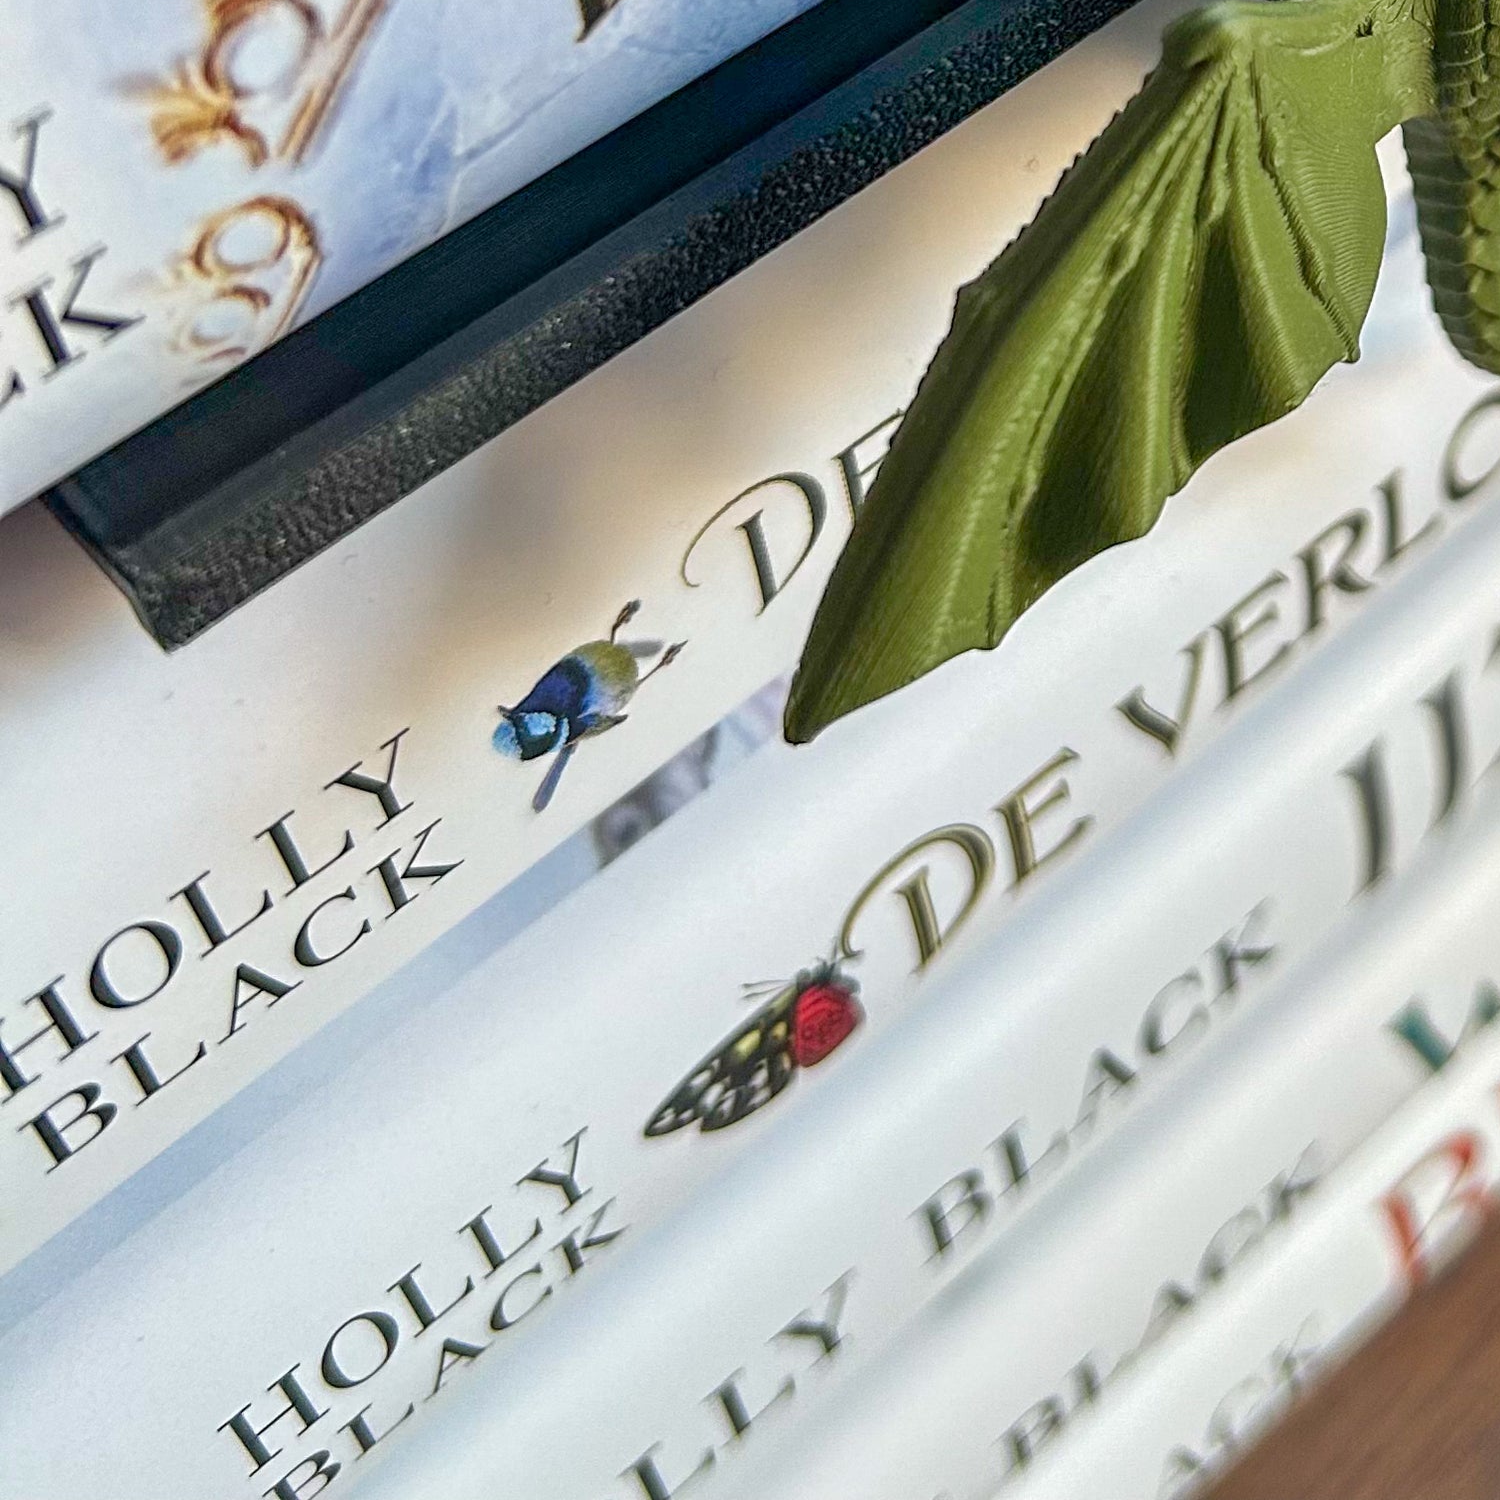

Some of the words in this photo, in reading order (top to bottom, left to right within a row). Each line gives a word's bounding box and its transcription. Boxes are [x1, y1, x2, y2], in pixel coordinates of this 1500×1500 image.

[0, 727, 414, 1101] HOLLY
[18, 817, 465, 1174] BLACK
[838, 745, 1097, 974] DE
[905, 898, 1281, 1270] BLACK
[216, 1125, 593, 1478] HOLLY
[262, 1196, 630, 1500] BLACK
[990, 1138, 1324, 1480] BLACK
